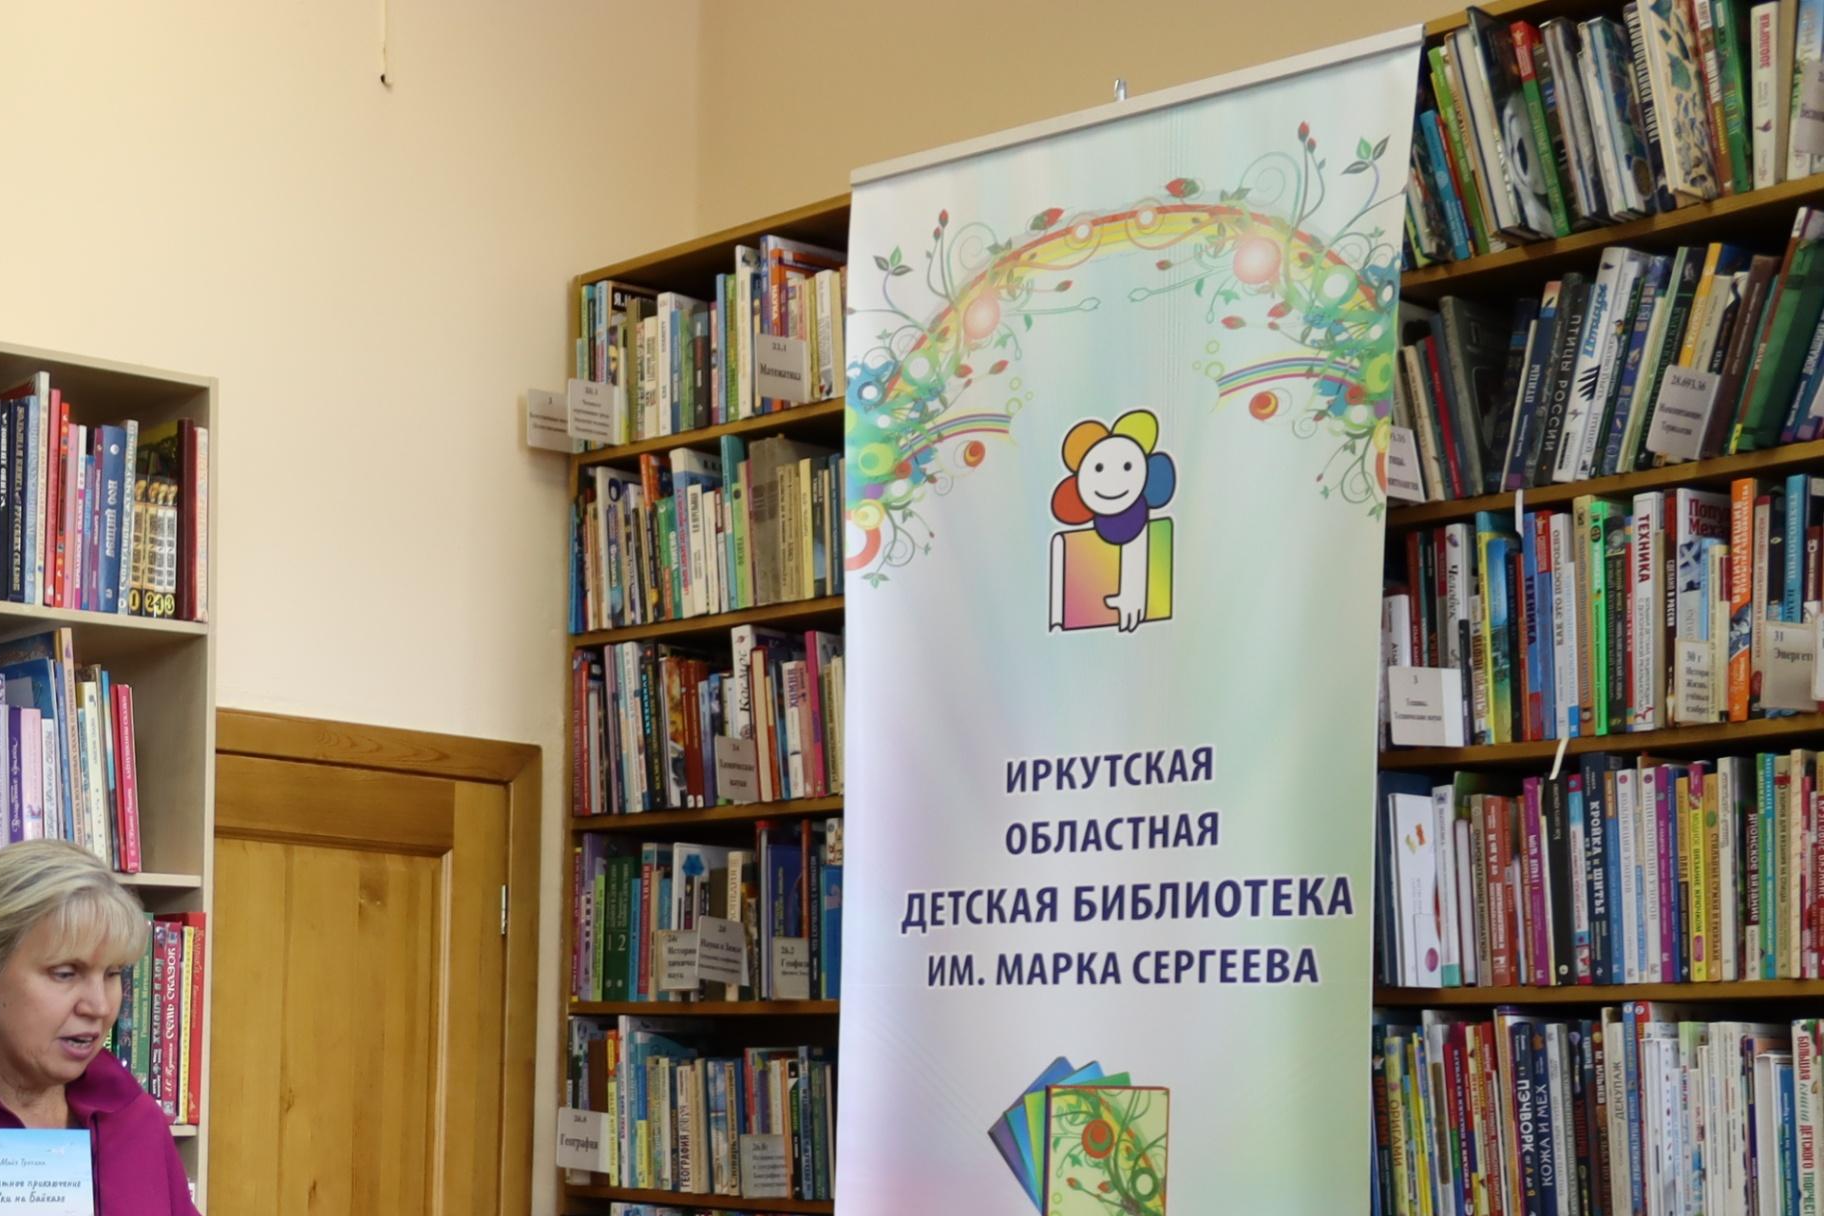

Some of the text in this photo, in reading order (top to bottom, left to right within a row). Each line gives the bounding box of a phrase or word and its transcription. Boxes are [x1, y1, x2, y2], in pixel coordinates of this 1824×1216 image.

[1544, 314, 1582, 451] ПТИЦЫ РОССИИ
[1637, 513, 1651, 584] ТЕХНИКА
[1007, 746, 1214, 794] ИРКУТСКАЯ
[1006, 812, 1219, 855] ОБЛАСТНАЯ
[1589, 799, 1603, 856] КРОЙКА
[901, 876, 1354, 934] ДЕТСКАЯ БИБЛИОТЕКА
[928, 947, 1319, 987] ИМ. МАРКА СЕРГЕЕВА
[1516, 1079, 1533, 1152] ПЭЧВОРК
[1612, 1061, 1625, 1121] ДЕКУПАЖ
[1390, 1099, 1403, 1167] ОРИГАМИ
[1535, 1083, 1553, 1187] КОЖА И МЕХ
